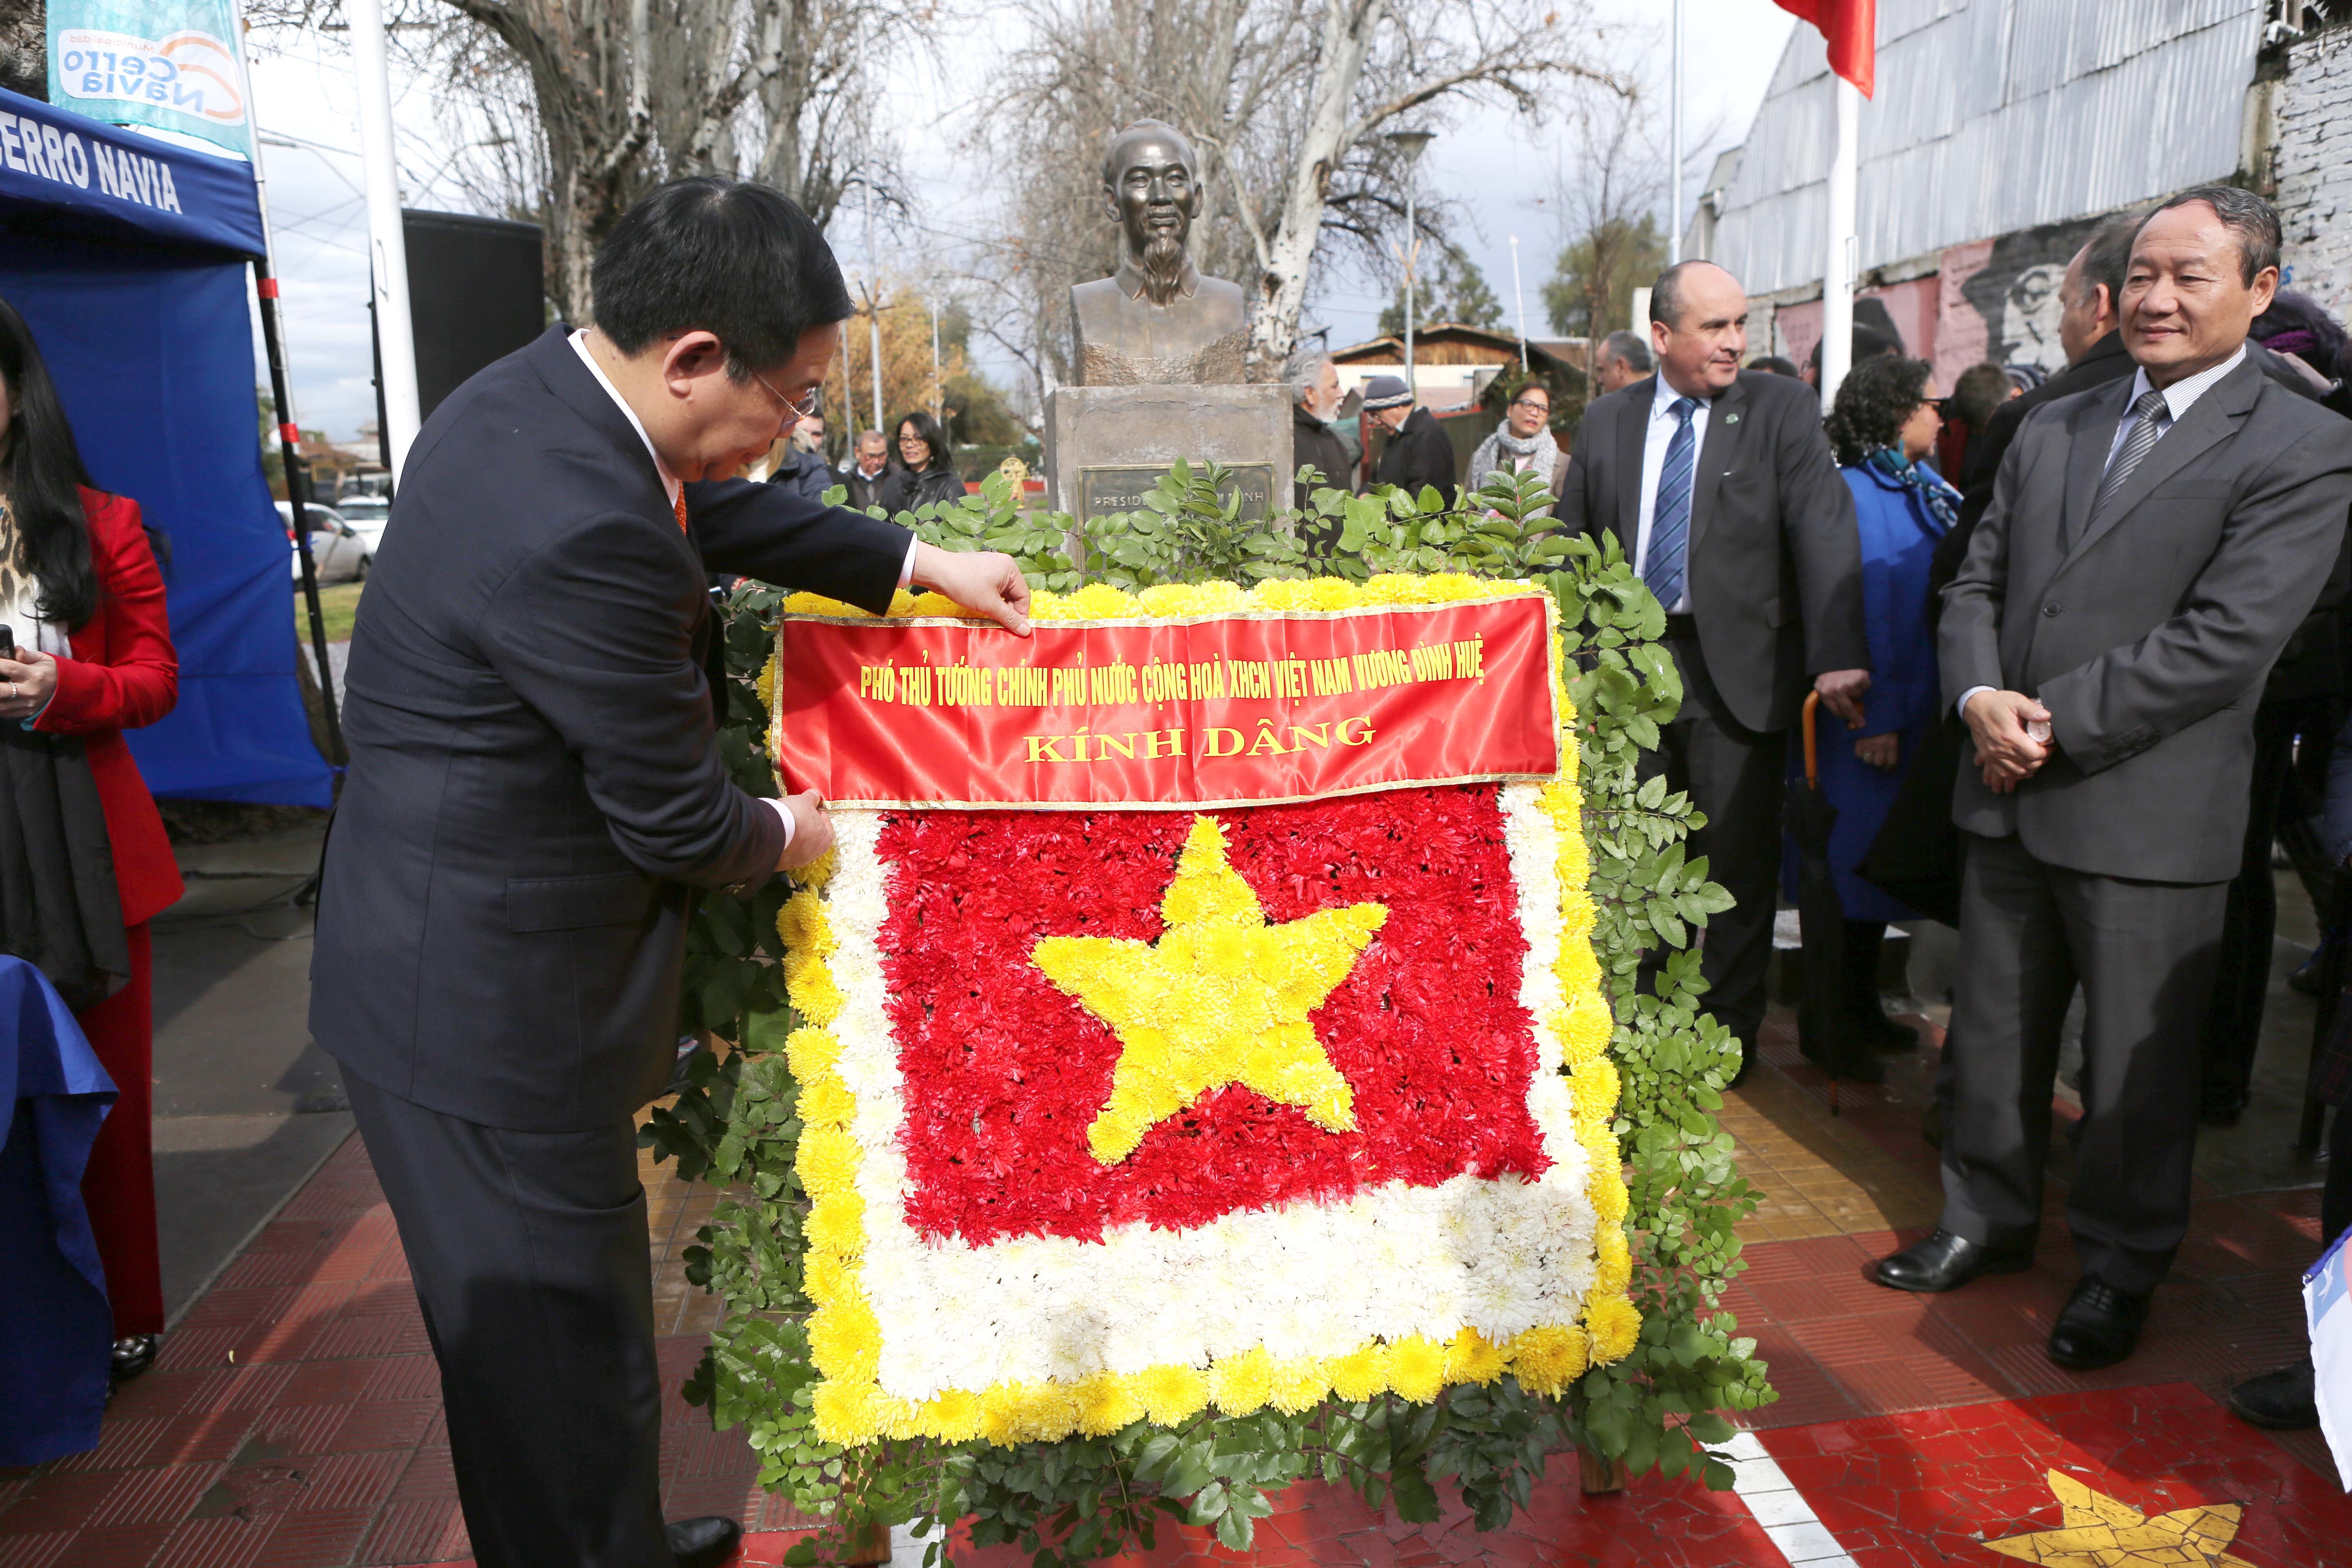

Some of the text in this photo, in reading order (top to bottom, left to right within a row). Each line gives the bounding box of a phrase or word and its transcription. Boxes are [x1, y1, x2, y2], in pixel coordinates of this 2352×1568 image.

[0, 110, 183, 214] ERRO NAVIA
[1094, 496, 1149, 507] PRESID
[860, 632, 1486, 711] PHÓ THỦ TƯỚNG CHÍNH PHỦ NƯỚC CỘNG HOÀ XHCN VIỆT NAM VƯƠNG ĐÌNH HUỆ
[1023, 715, 1376, 763] KÍNH DÂNG
